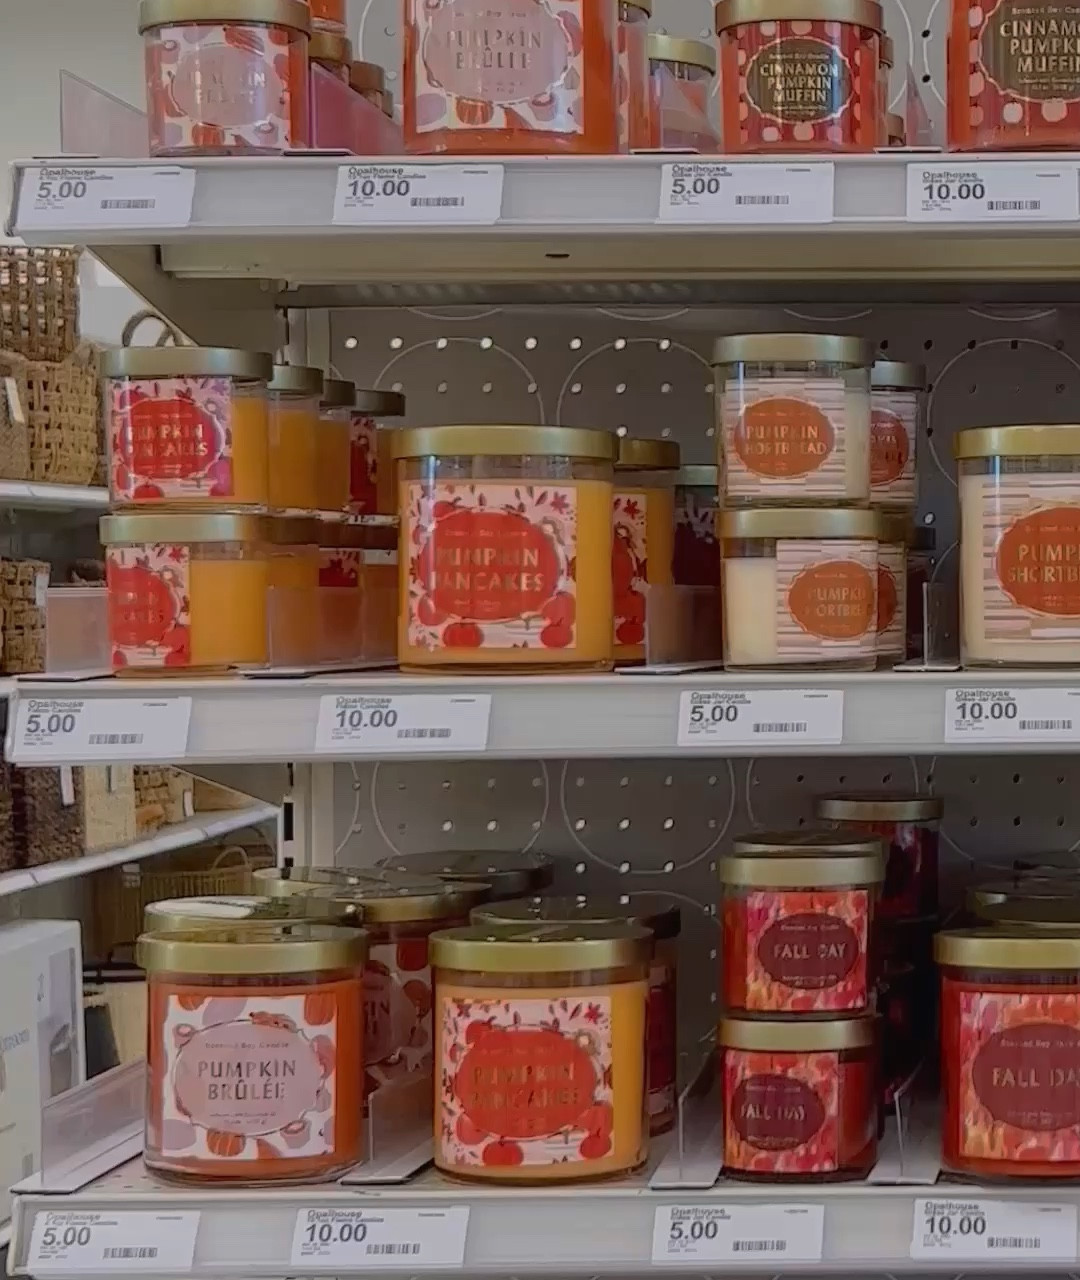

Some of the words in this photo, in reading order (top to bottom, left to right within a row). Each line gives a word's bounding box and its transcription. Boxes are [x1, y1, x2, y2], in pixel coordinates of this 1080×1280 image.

[760, 63, 838, 78] CINNAMON
[767, 76, 832, 90] PUMPKIN
[772, 89, 827, 102] MUFFIN
[37, 181, 87, 198] 5.00
[348, 179, 411, 197] 10.00
[671, 178, 721, 195] 5.00
[924, 183, 986, 200] 10.00
[335, 709, 398, 728] 10.00
[690, 705, 739, 722] 5.00
[956, 703, 1018, 720] 10.00
[26, 714, 76, 733] 5.00
[773, 942, 811, 959] FALL
[197, 1059, 297, 1079] PUMPKIN
[991, 1066, 1041, 1088] FALL
[304, 1223, 368, 1242] 10.00
[670, 1221, 719, 1240] 5.00
[924, 1216, 987, 1235] 10.00
[42, 1226, 92, 1246] 5.00
